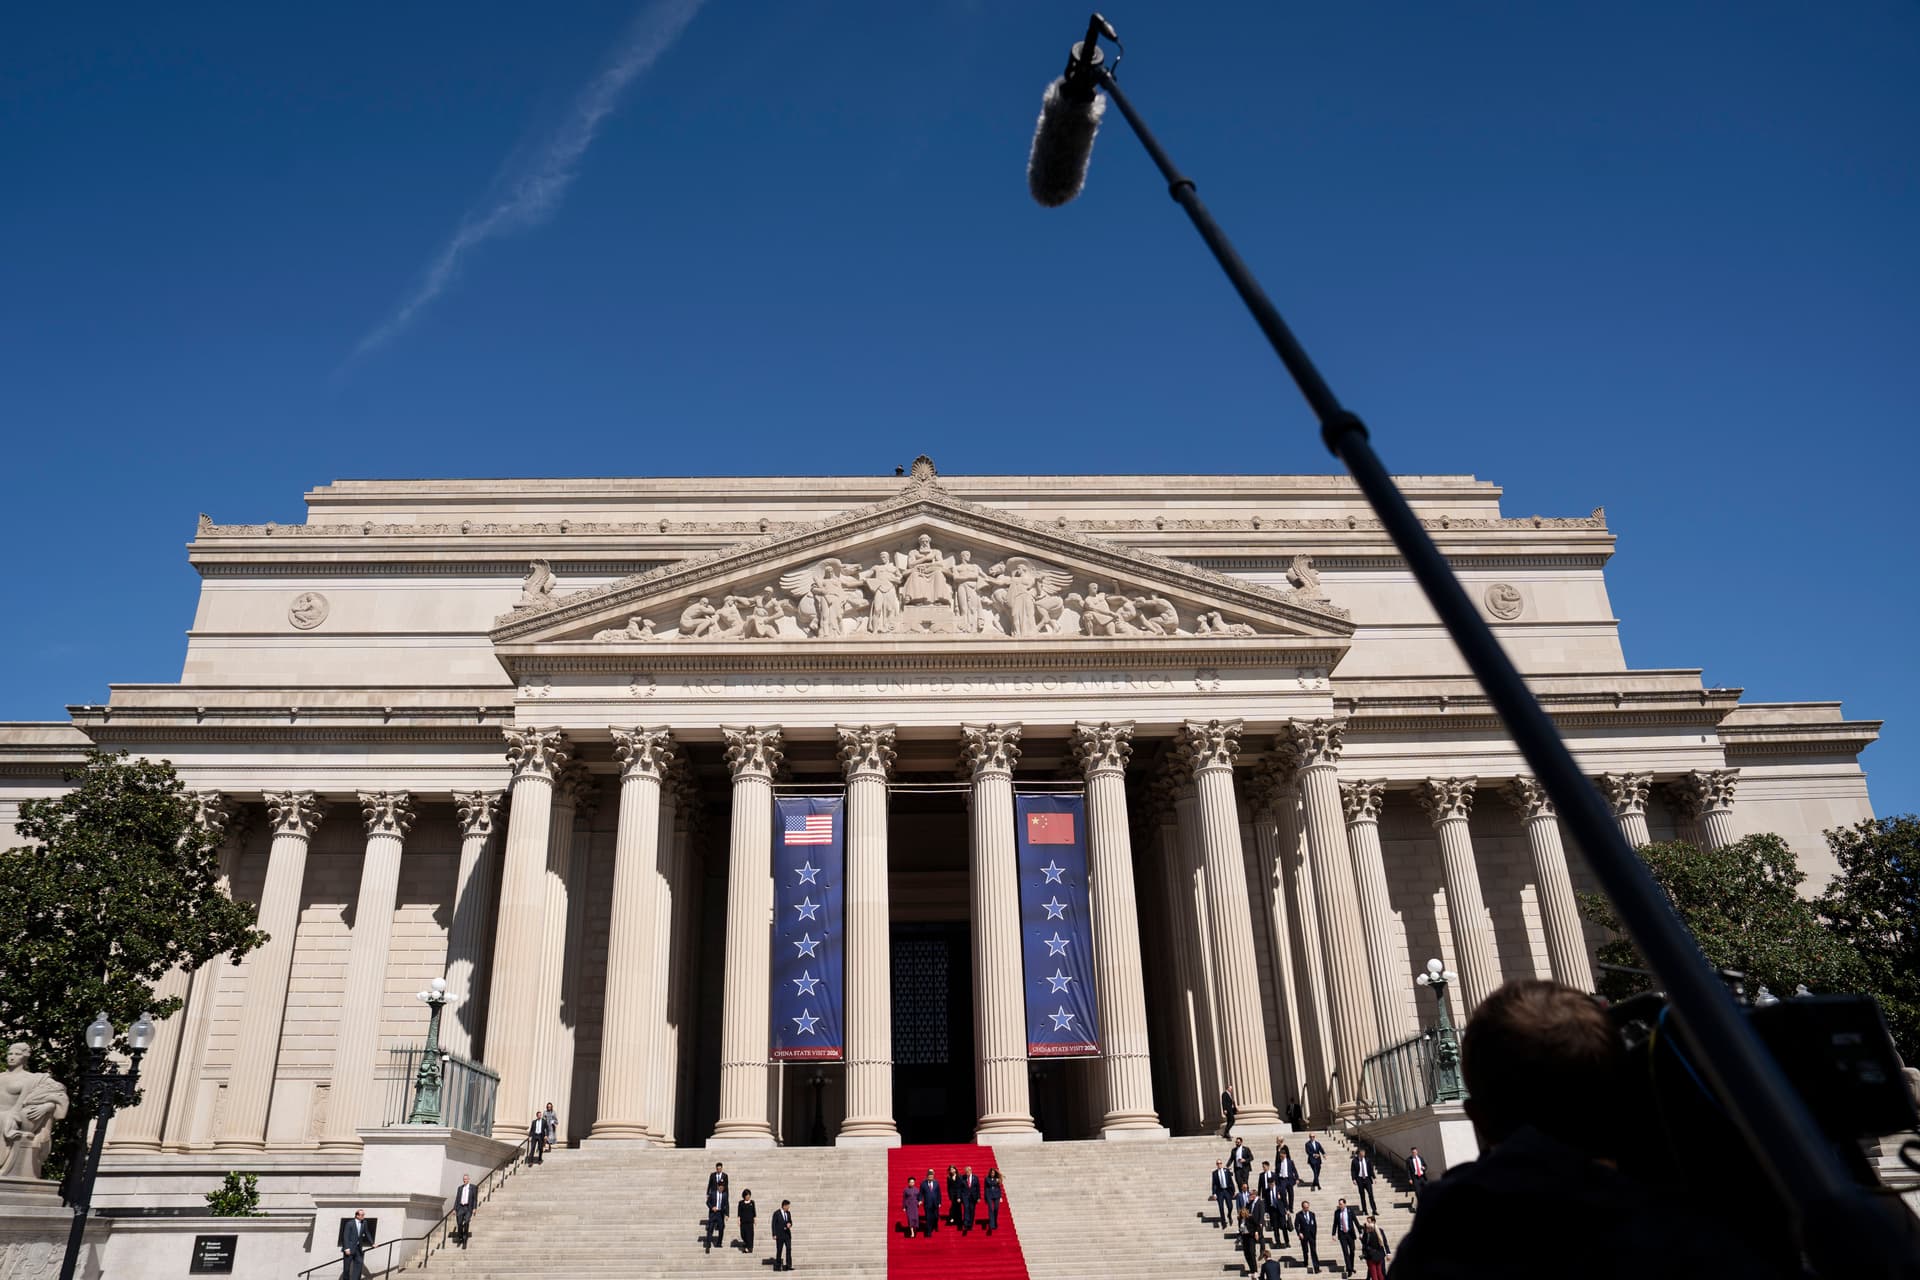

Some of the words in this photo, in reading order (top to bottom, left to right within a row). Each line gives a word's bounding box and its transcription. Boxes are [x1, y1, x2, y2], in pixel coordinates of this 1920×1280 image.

[681, 677, 786, 694] ARCHIVES
[794, 678, 821, 693] OF
[827, 677, 865, 693] THE
[876, 675, 953, 693] UNITED
[963, 675, 1033, 692] STATES
[1042, 675, 1068, 691] OF
[1074, 673, 1175, 690] AMERICA
